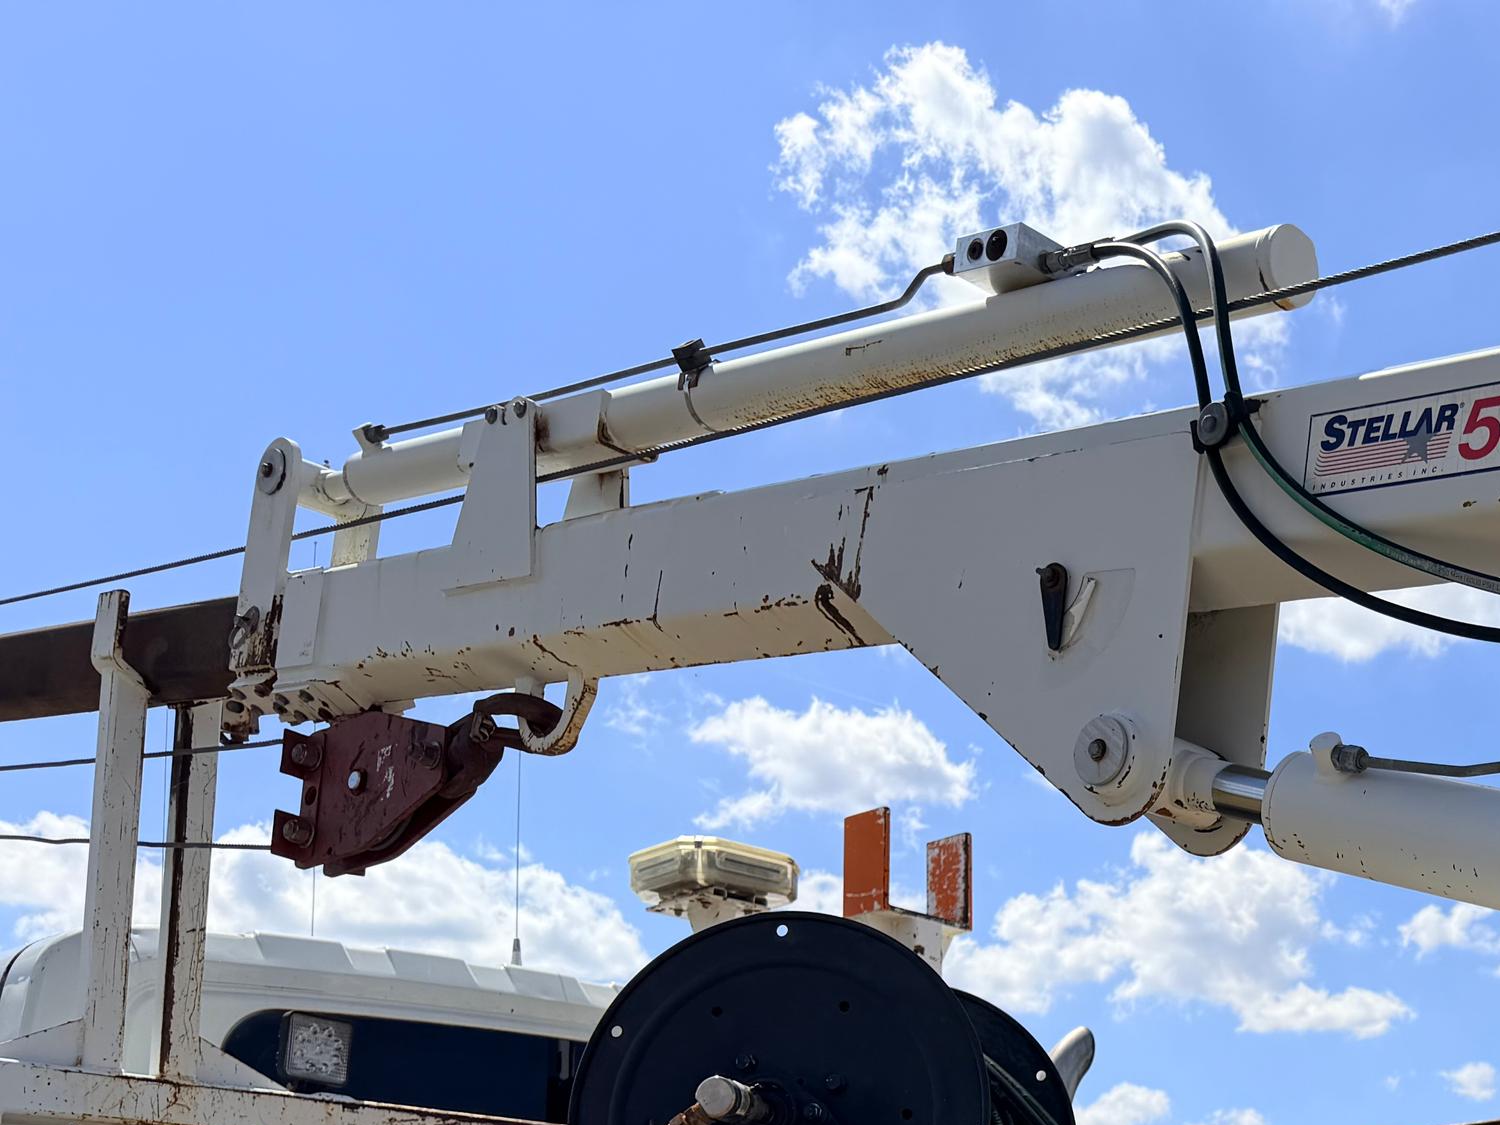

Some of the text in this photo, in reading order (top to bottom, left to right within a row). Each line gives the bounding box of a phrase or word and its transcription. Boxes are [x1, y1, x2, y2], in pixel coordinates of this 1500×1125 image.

[1321, 403, 1458, 451] STELLAR
[1312, 467, 1444, 491] INDUSTRIES INC.
